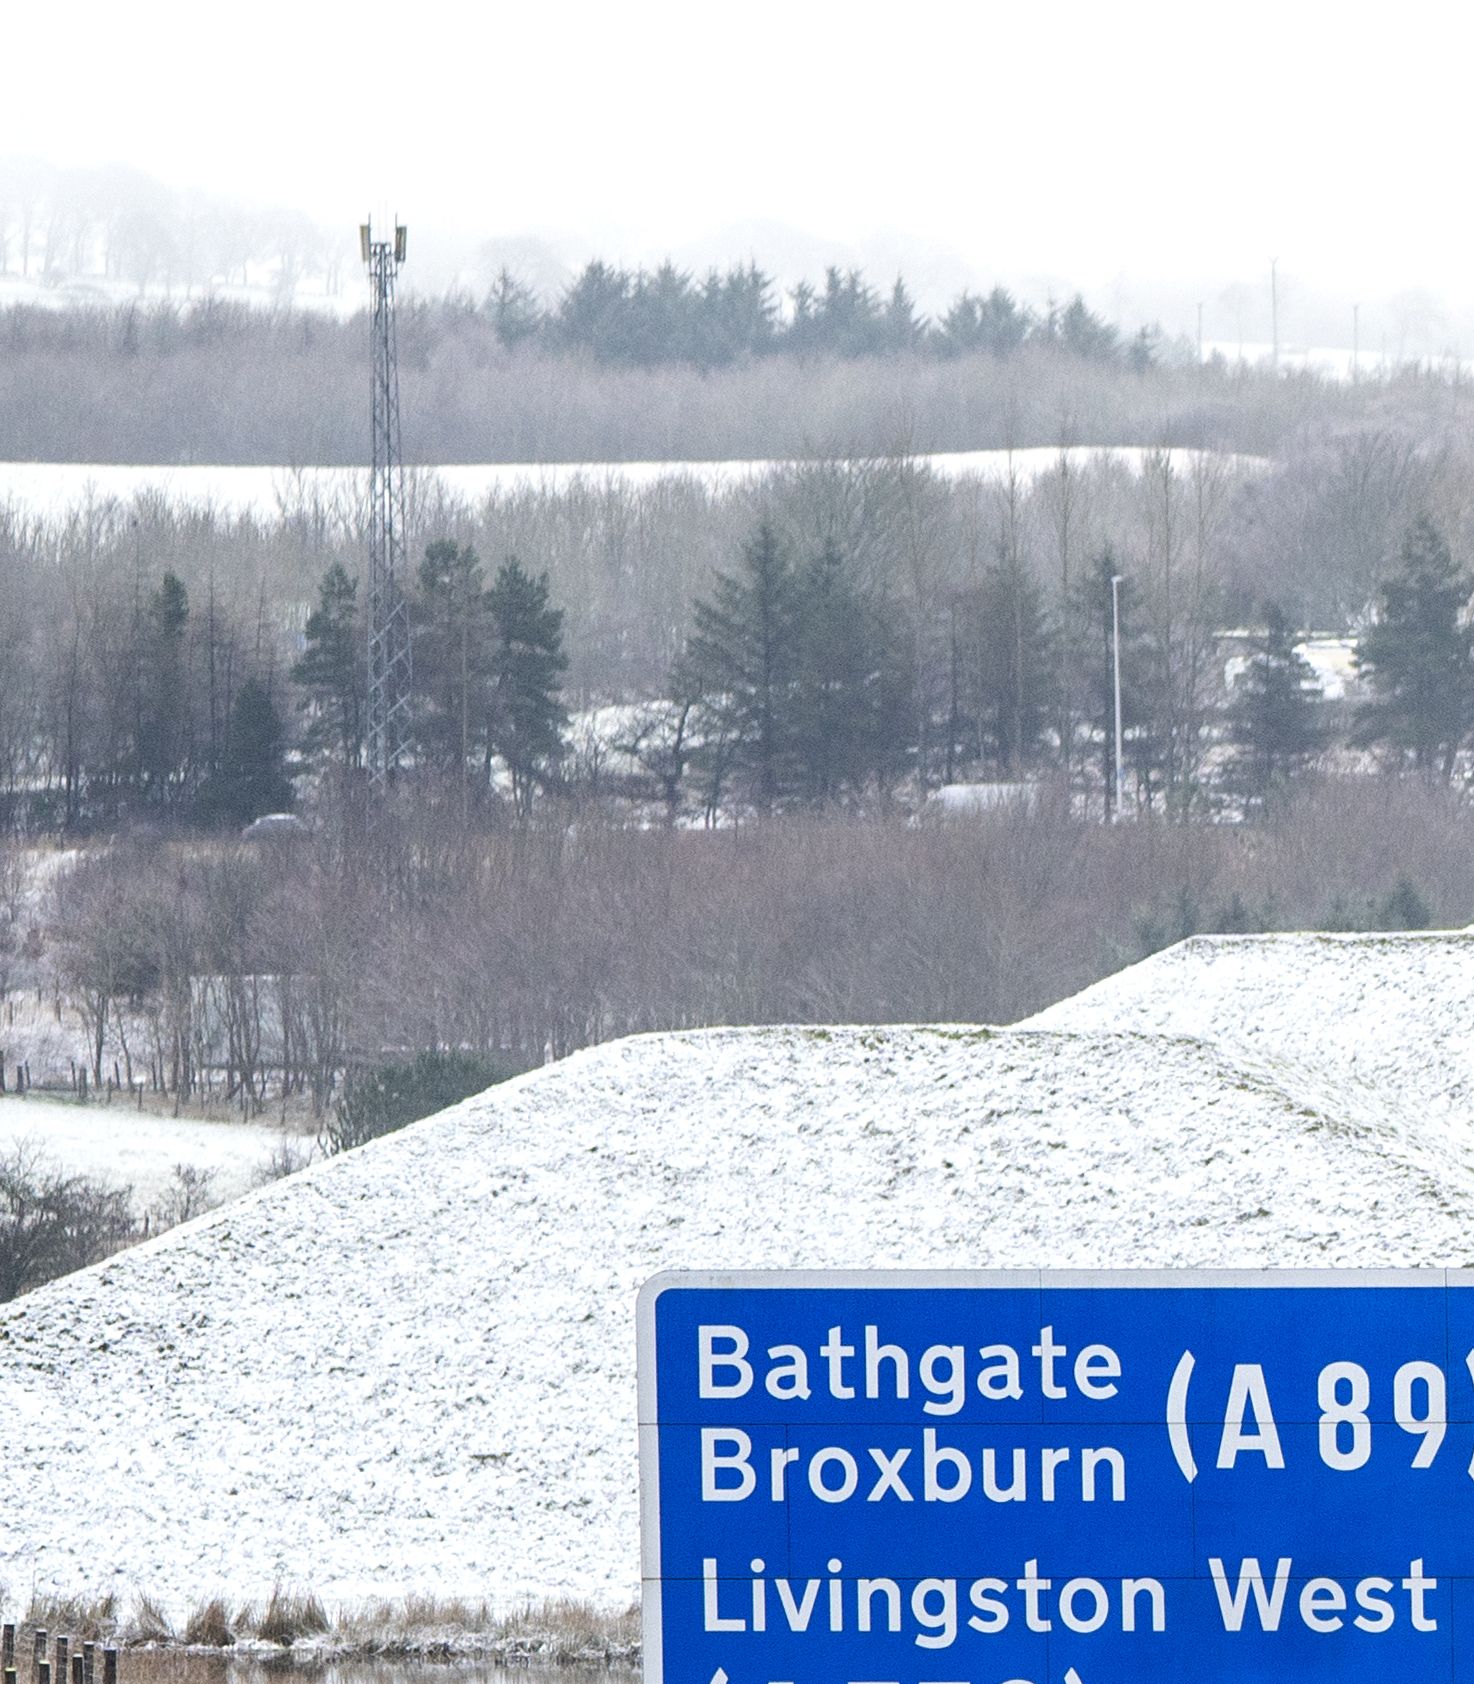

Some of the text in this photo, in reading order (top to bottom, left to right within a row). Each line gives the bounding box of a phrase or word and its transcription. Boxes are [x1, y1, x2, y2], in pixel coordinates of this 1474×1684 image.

[698, 1325, 1122, 1416] Bathgate
[700, 1427, 1126, 1503] Broxburn
[702, 1557, 1438, 1649] Livingston West
